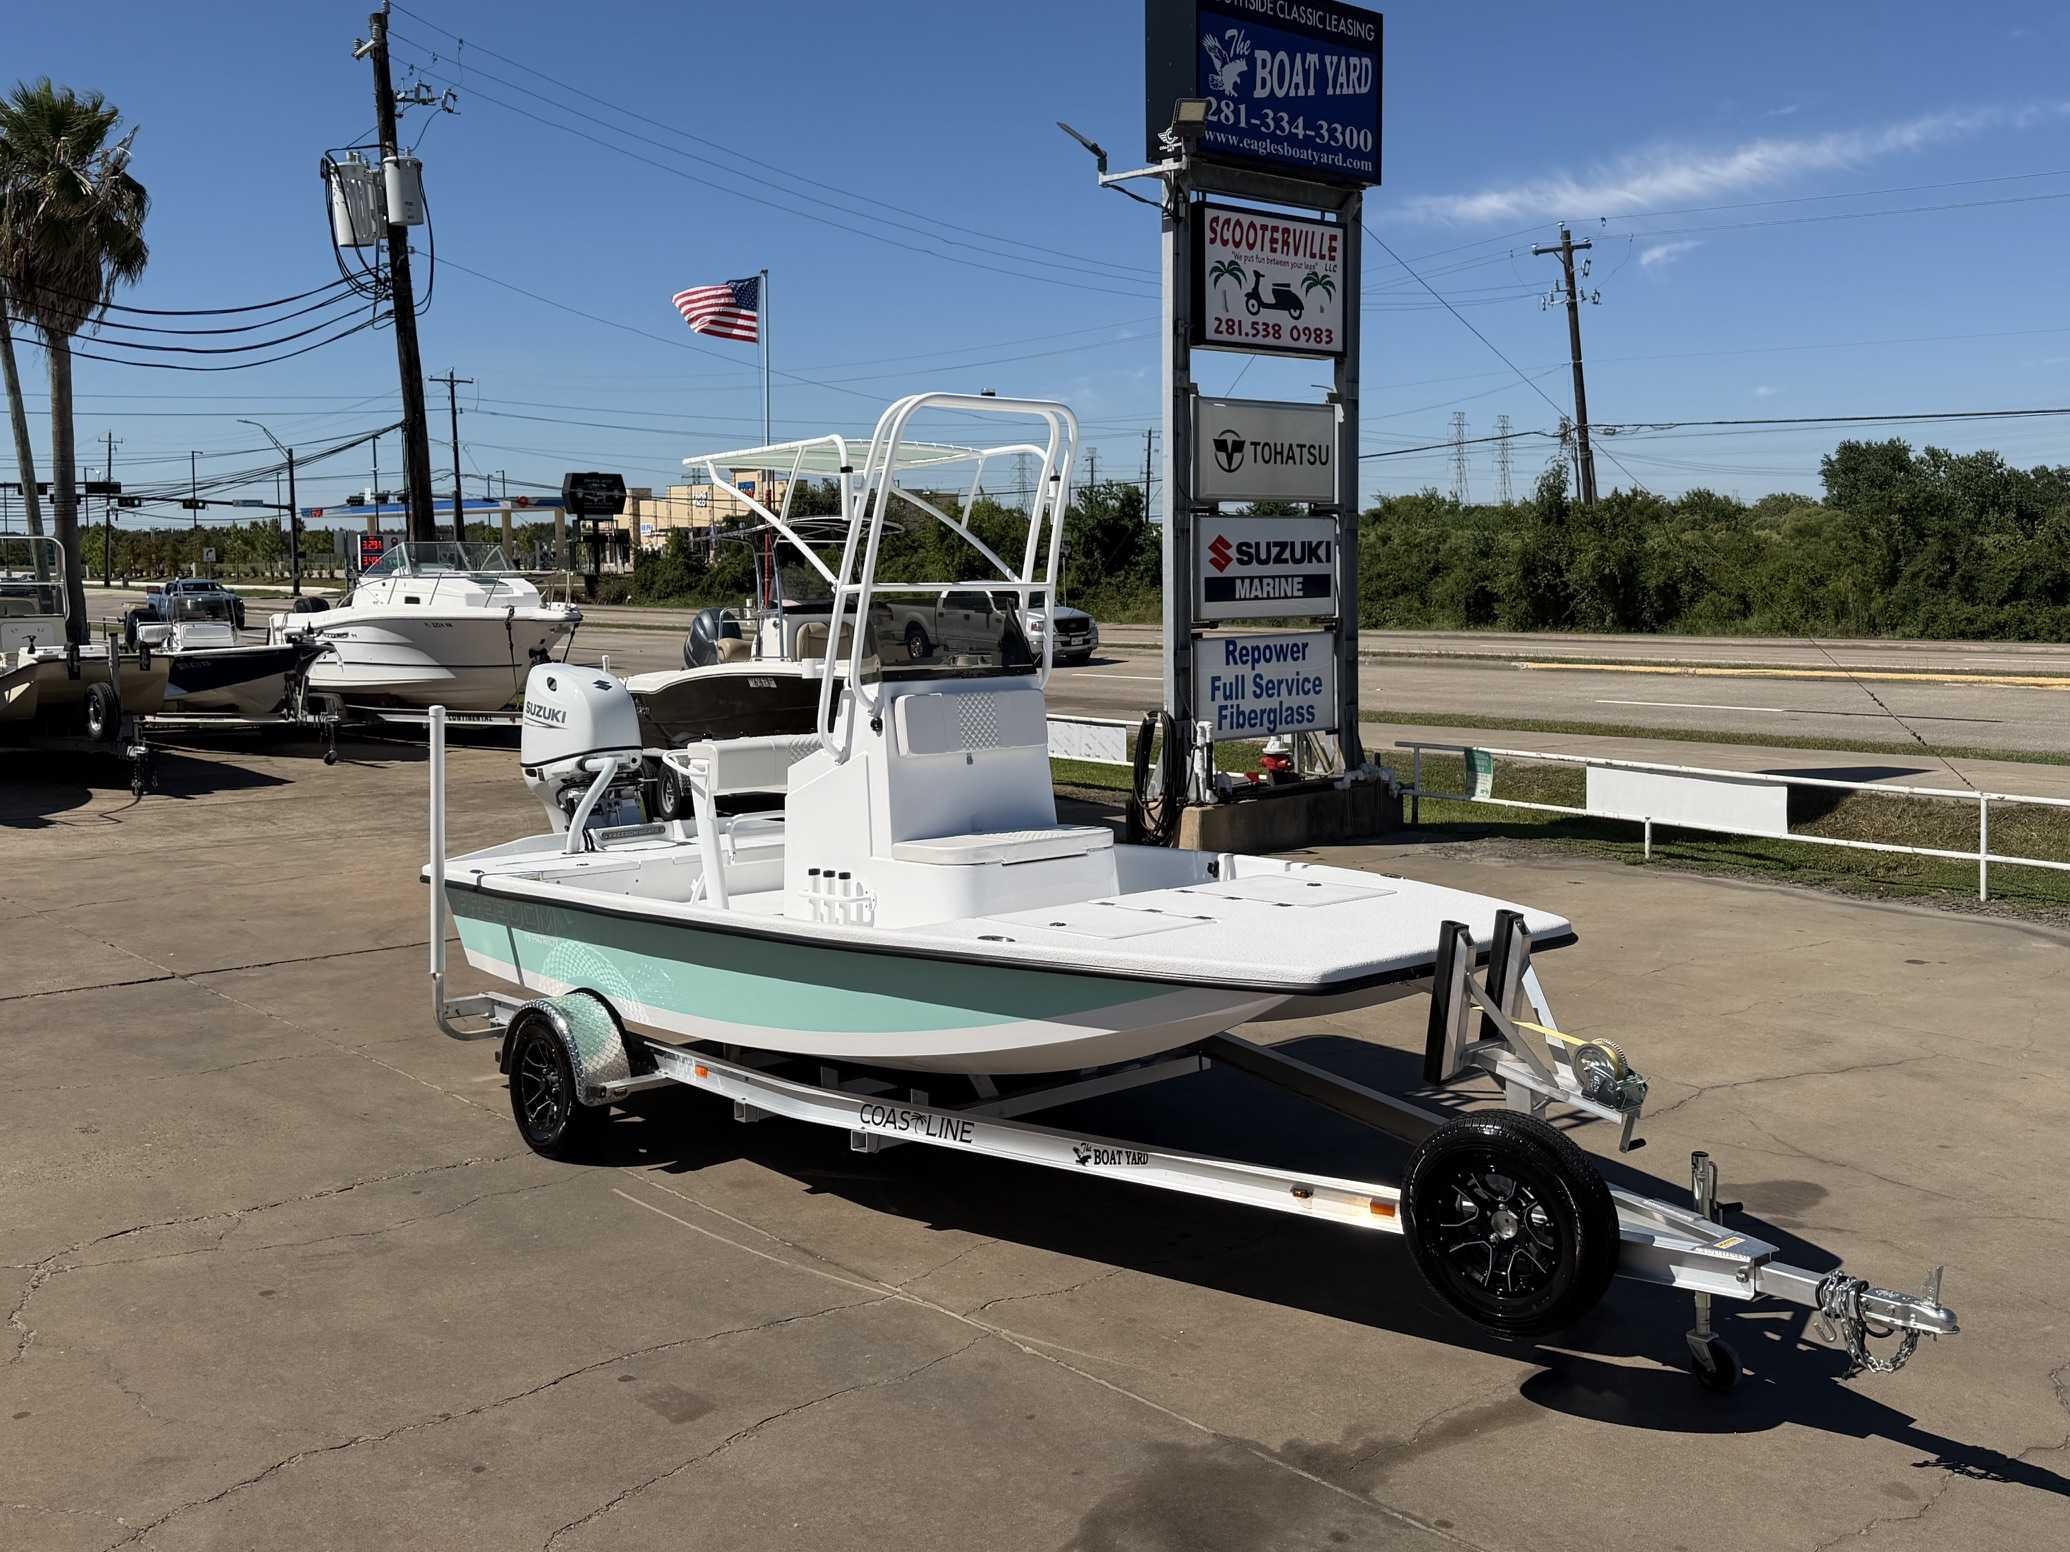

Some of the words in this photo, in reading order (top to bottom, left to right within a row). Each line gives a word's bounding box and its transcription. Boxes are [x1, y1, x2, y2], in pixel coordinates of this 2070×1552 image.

[1276, 1, 1324, 29] CLASSIC
[1325, 12, 1376, 42] LEASING
[1224, 28, 1251, 57] The
[1253, 49, 1319, 99] BOAT
[1324, 54, 1373, 96] YARD
[1206, 96, 1373, 152] 281-334-3300
[1203, 129, 1373, 172] www.eaglesboatyard.com
[1208, 215, 1338, 262] SCOOTERVILLE
[1324, 263, 1338, 273] LLC
[1213, 316, 1282, 340] 281.538
[1289, 325, 1334, 345] 0983
[1250, 441, 1329, 466] TOHATSU
[1235, 540, 1331, 566] SUZUKI
[1235, 576, 1304, 600] MARINE
[1225, 639, 1309, 671] Repower
[1210, 674, 1245, 701] Full
[1252, 671, 1322, 699] Service
[525, 700, 567, 724] SUZUKI
[1217, 701, 1315, 733] Fiberglass
[1093, 1149, 1123, 1166] BOAT
[1125, 1150, 1149, 1166] YARD
